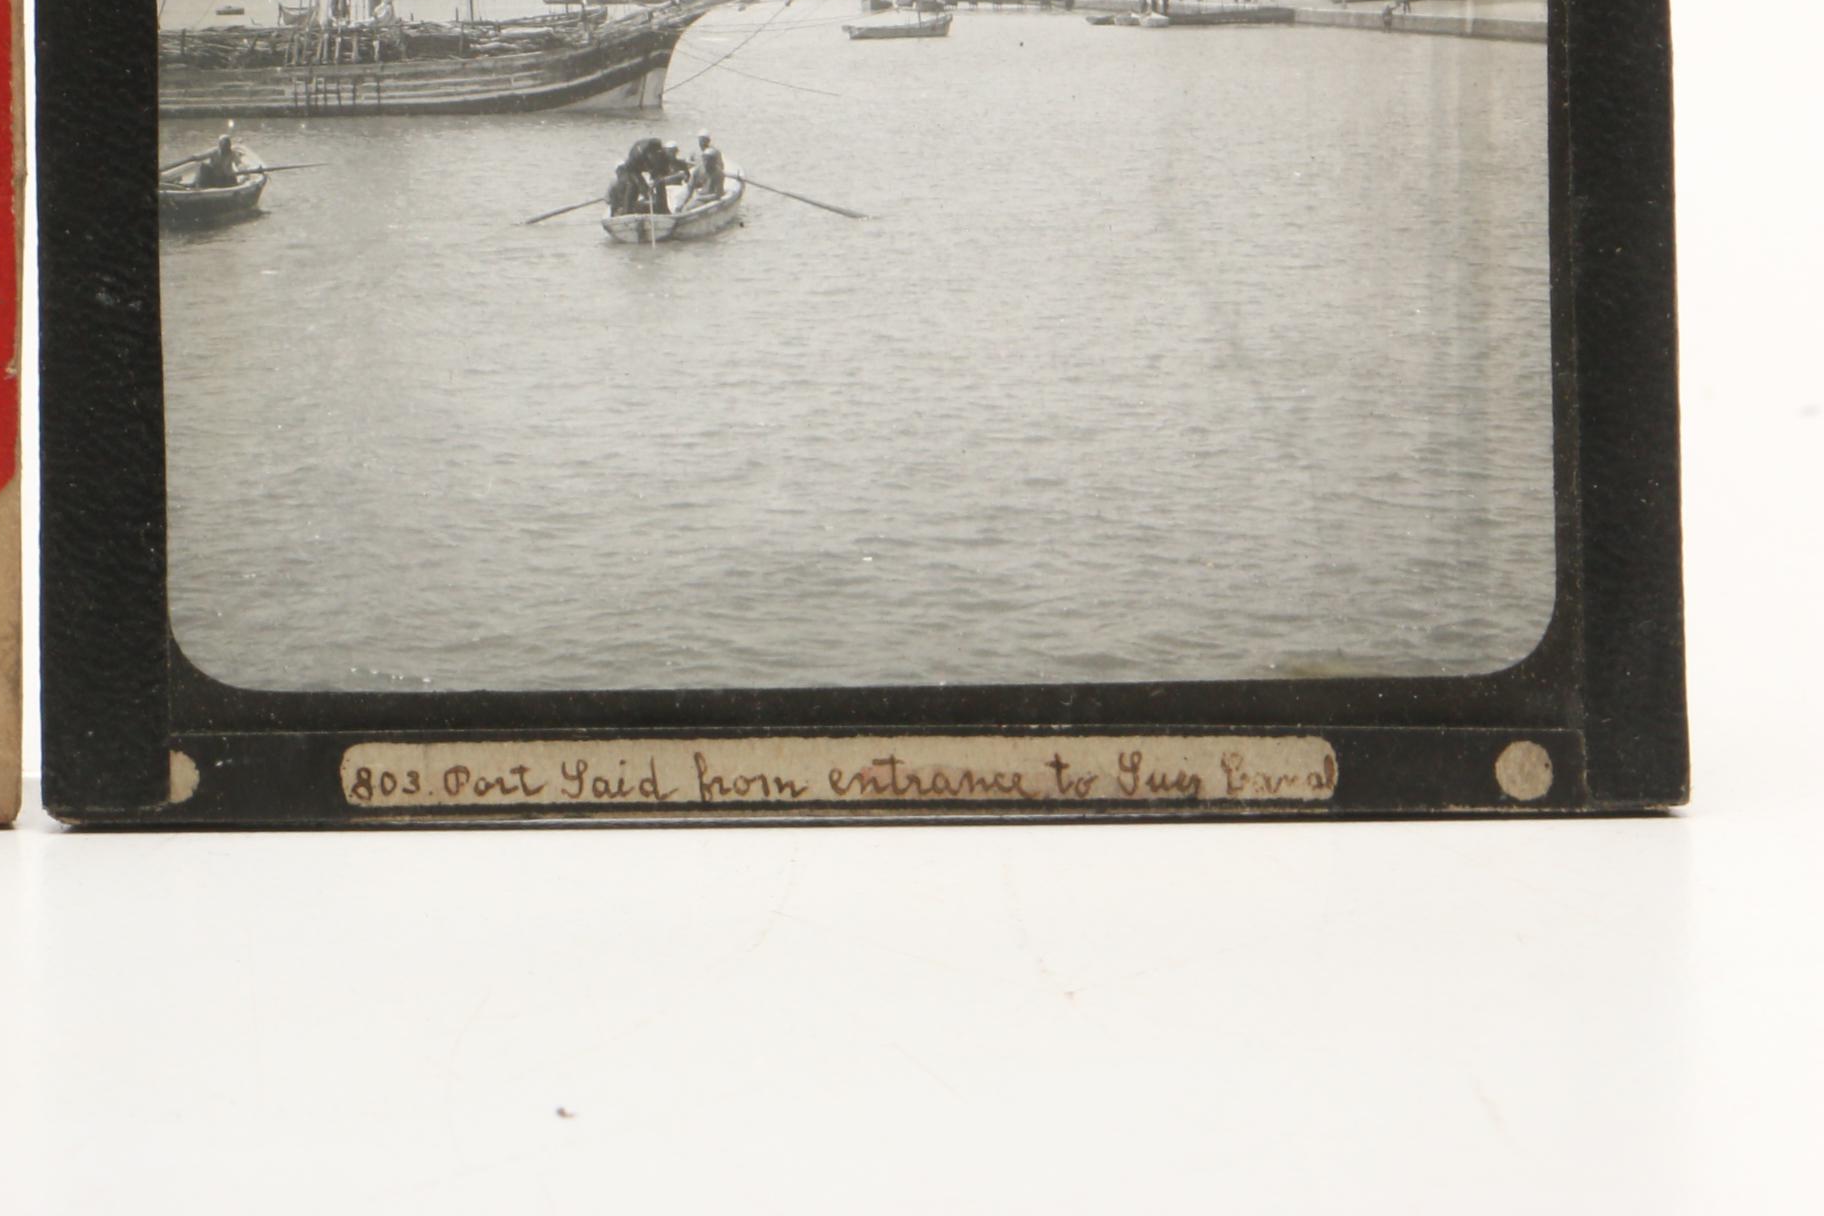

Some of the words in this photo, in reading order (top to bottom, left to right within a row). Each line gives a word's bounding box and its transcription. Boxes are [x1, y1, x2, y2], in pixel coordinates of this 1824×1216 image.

[443, 764, 546, 797] Port
[561, 756, 679, 801] Said
[694, 751, 810, 801] from
[828, 754, 1038, 798] entrance
[1045, 752, 1097, 798] to
